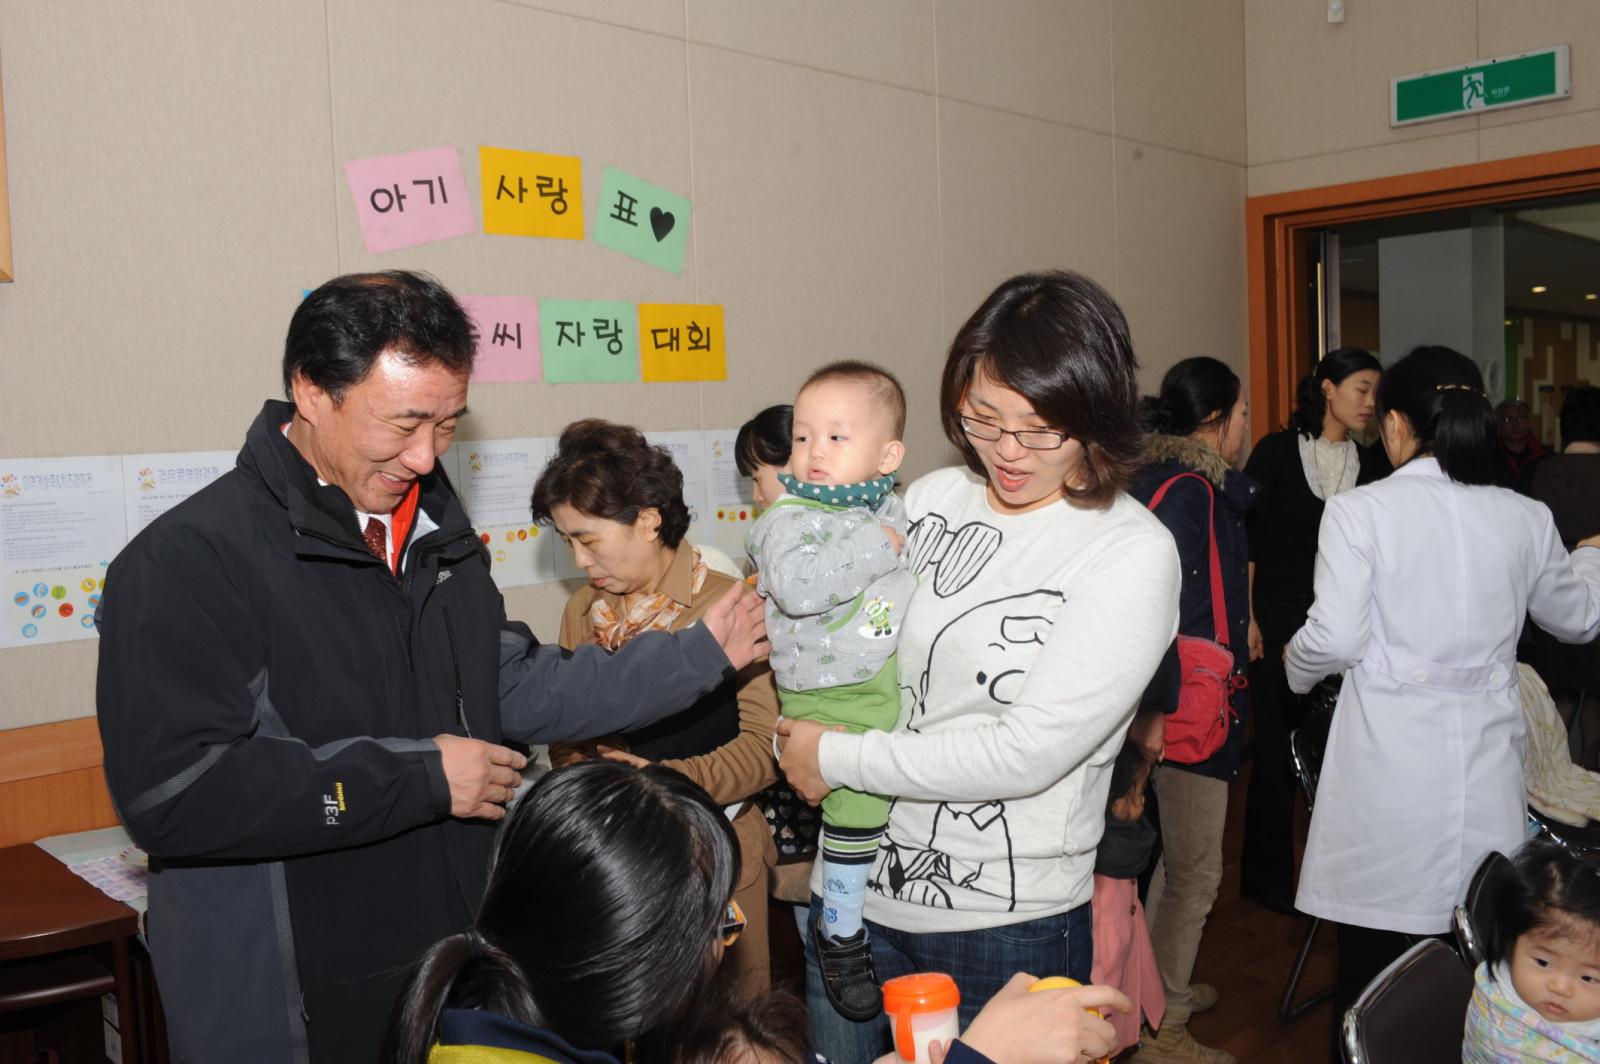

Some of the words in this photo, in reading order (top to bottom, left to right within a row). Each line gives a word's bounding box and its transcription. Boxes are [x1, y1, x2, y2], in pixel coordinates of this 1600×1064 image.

[369, 175, 449, 214] 아기
[495, 174, 569, 216] 사랑
[609, 189, 639, 228] 표
[554, 317, 624, 356] 자랑
[650, 320, 712, 353] 대회
